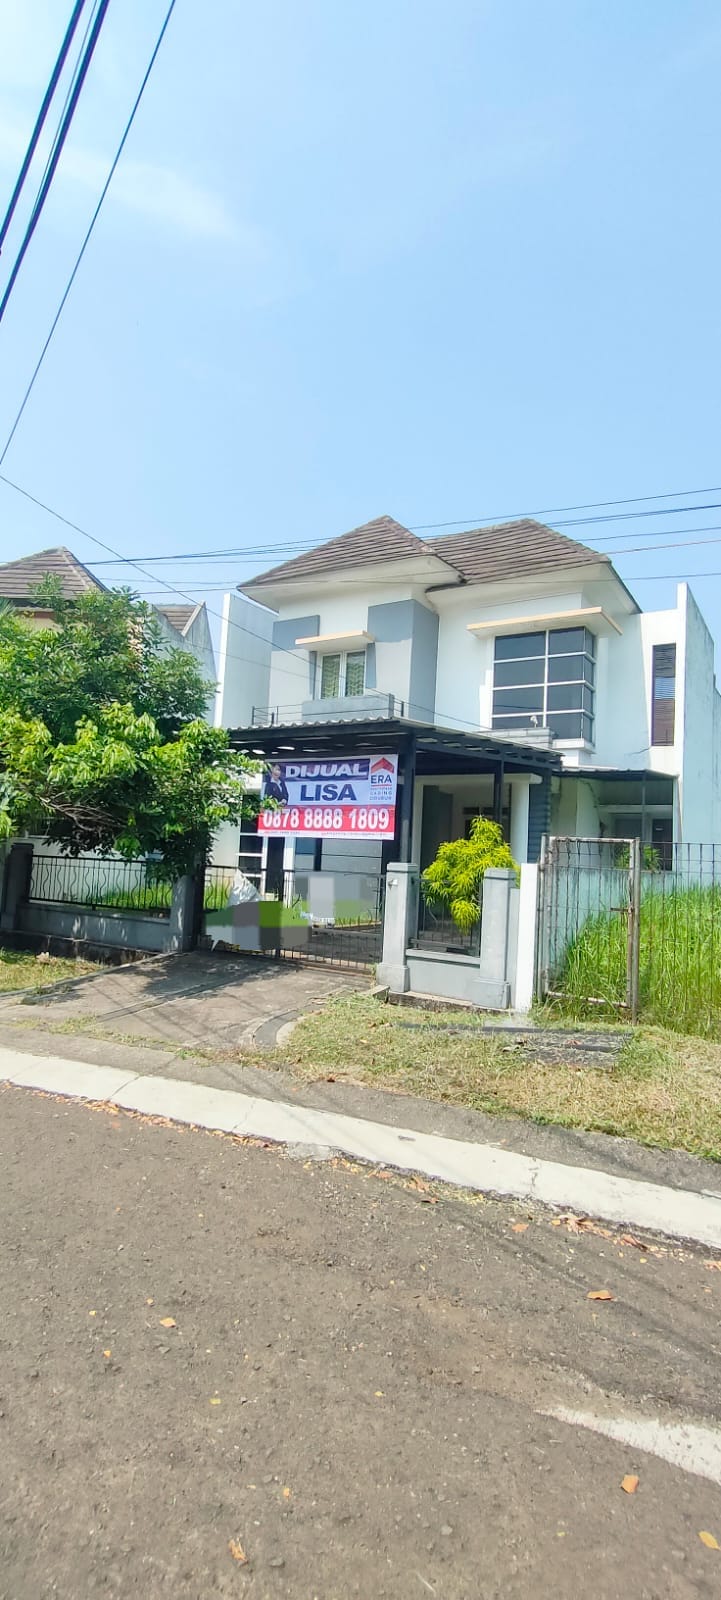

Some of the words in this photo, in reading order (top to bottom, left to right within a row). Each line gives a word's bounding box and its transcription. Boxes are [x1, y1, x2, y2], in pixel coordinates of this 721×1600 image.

[285, 763, 367, 778] DIJUAL
[370, 774, 392, 784] ERA
[300, 784, 357, 802] LISA
[263, 808, 300, 828] 0878
[303, 808, 343, 829] 8888
[348, 808, 390, 830] 1809
